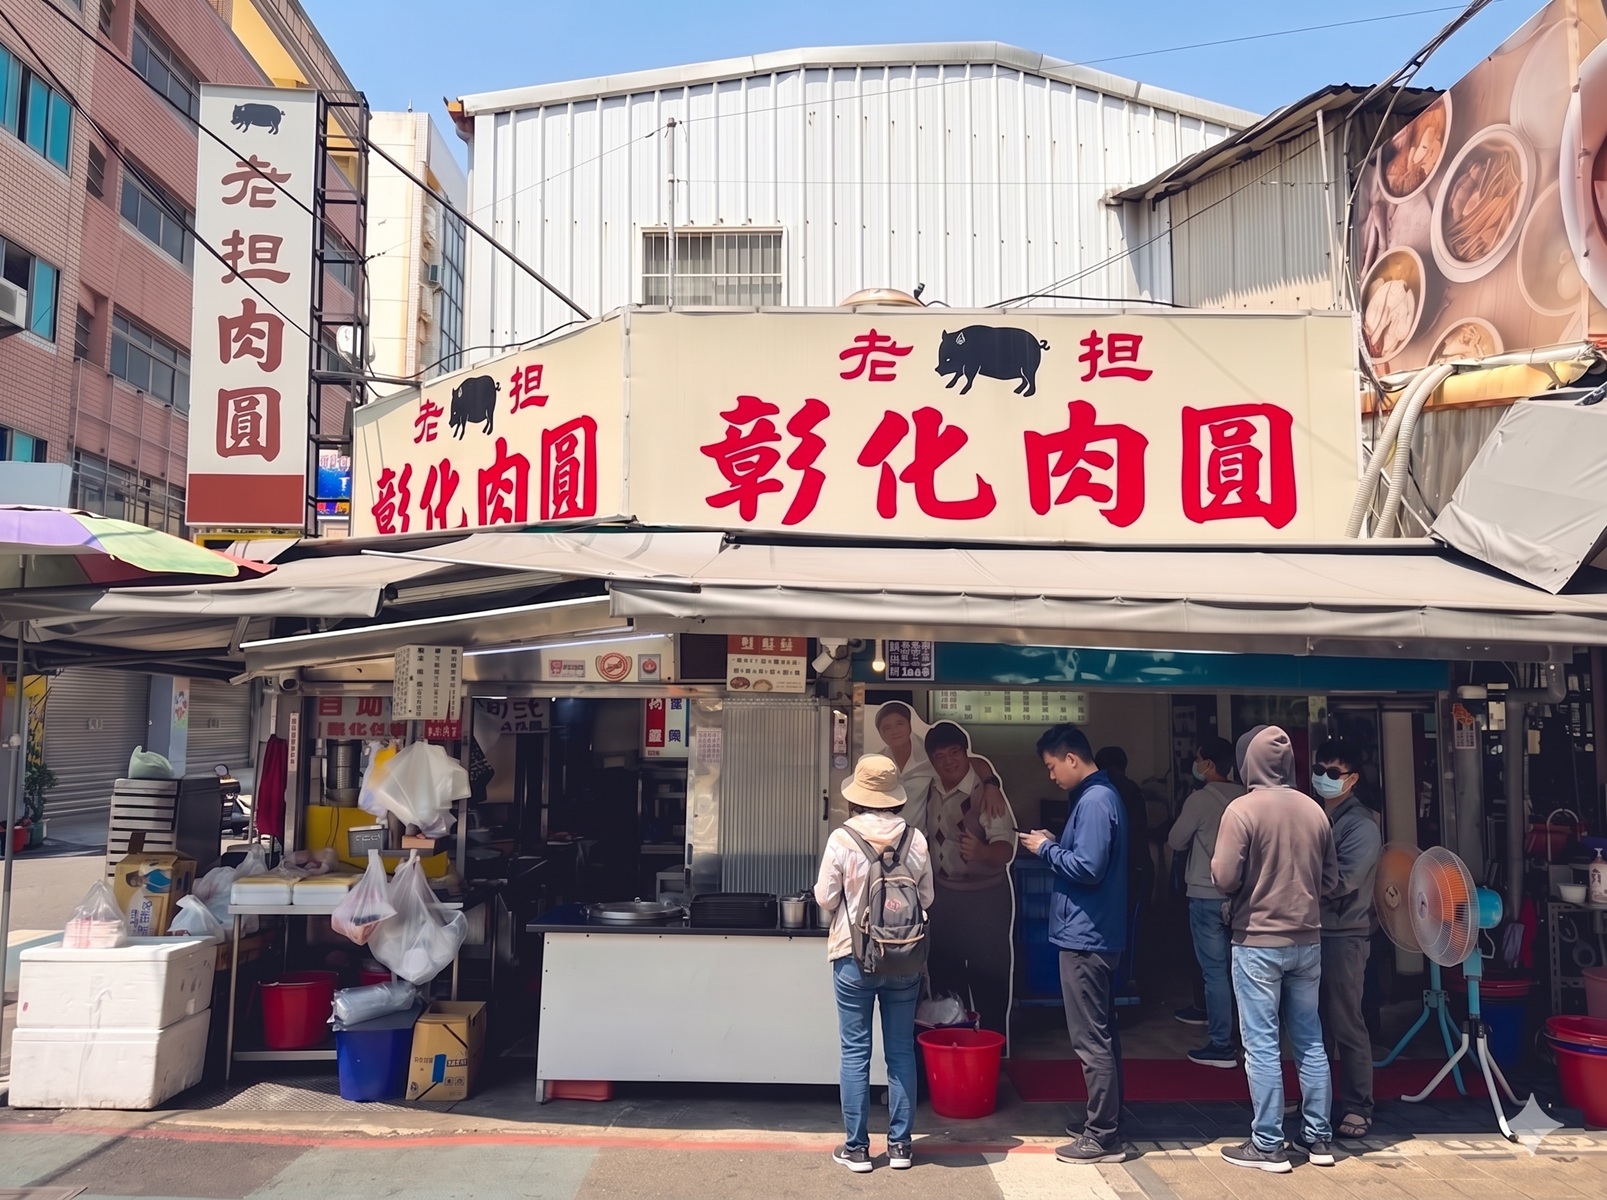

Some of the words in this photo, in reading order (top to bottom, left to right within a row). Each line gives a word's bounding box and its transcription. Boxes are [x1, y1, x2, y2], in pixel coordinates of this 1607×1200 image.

[216, 155, 291, 463] 老担肉圓
[839, 329, 913, 383] 老
[1078, 330, 1153, 383] 担
[414, 399, 444, 444] 老
[509, 364, 549, 414] 担
[700, 395, 1298, 530] 彰化肉圓
[371, 414, 598, 535] 彰化肉圓
